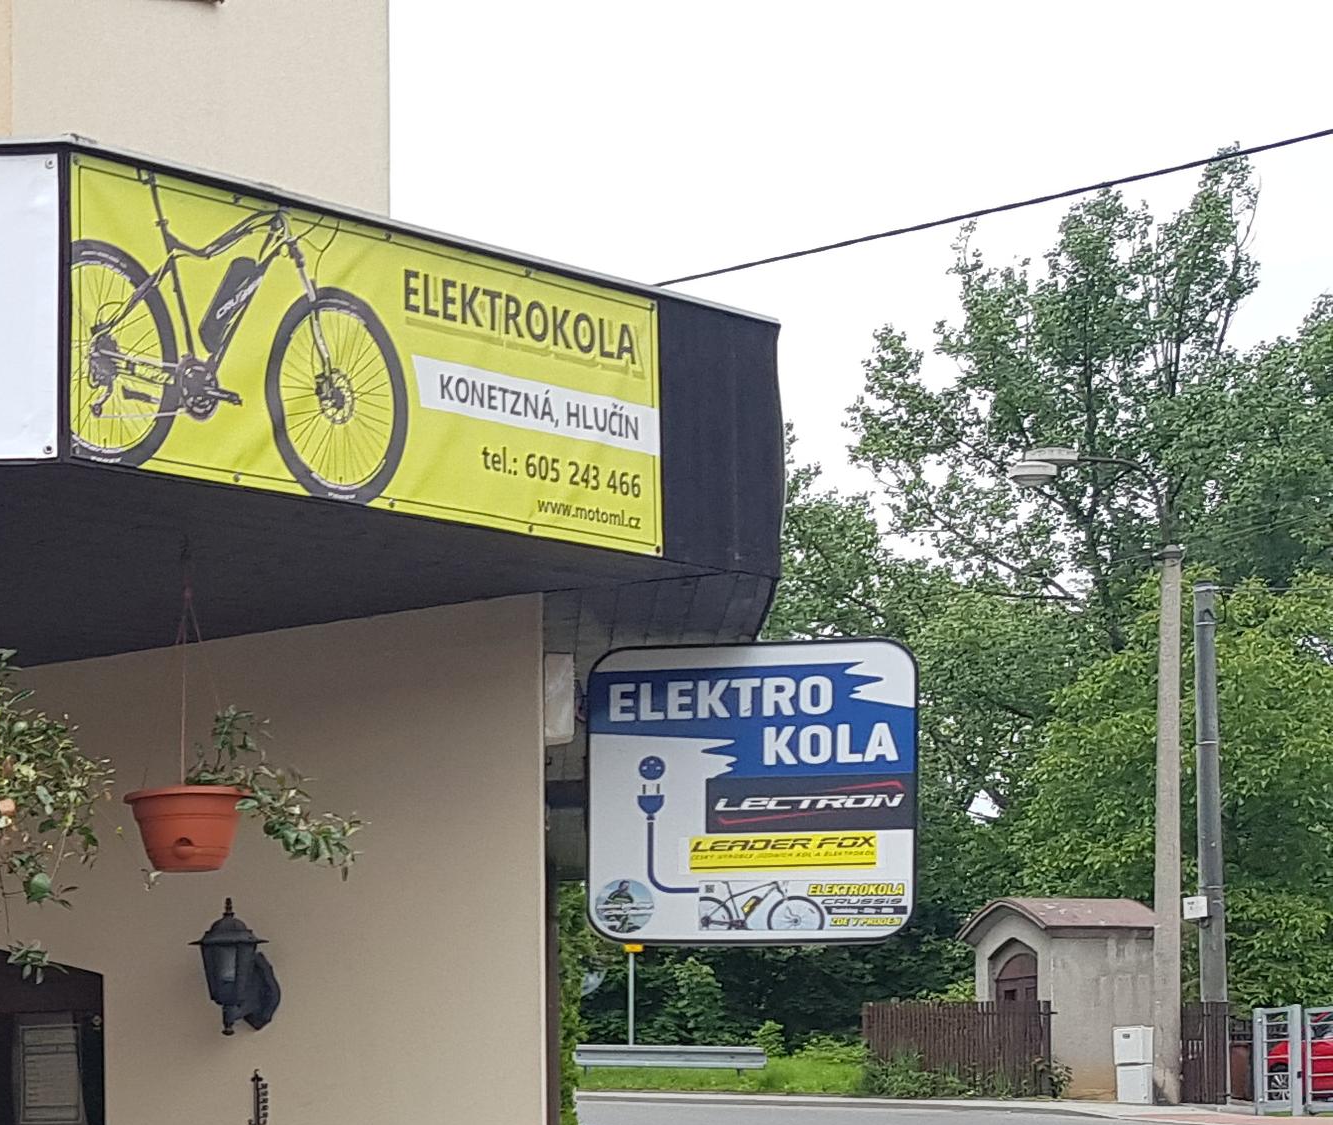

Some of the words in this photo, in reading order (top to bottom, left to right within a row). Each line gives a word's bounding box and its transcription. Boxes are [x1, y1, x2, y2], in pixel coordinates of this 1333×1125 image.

[403, 268, 637, 366] ELEKTROKOLA
[439, 373, 560, 429] KONETZNÁ,
[566, 401, 640, 441] HLUČÍN
[482, 446, 519, 476] tel.:
[525, 453, 561, 482] 605
[568, 461, 601, 491] 243
[606, 469, 642, 498] 466
[537, 499, 642, 530] www.motoml.cz
[608, 675, 834, 723] ELEKTRO
[762, 722, 899, 767] KOLA
[691, 838, 813, 853] LEADER
[816, 835, 876, 849] FOX
[807, 883, 905, 896] ELEKTROKOLA
